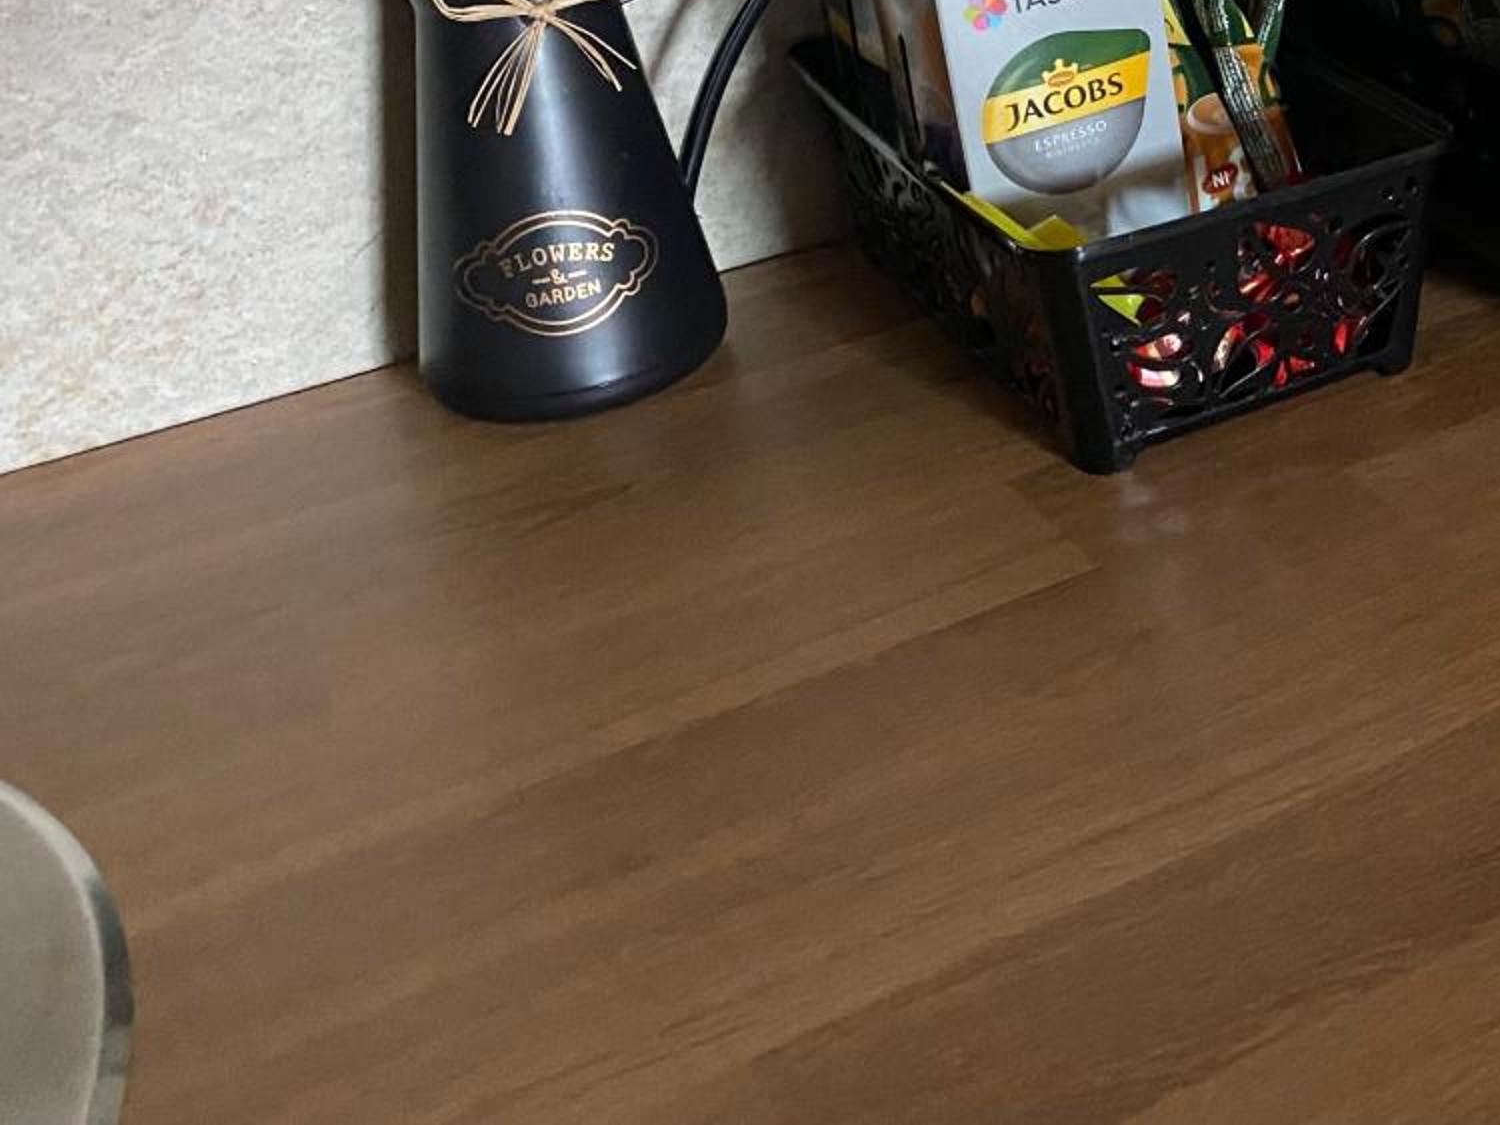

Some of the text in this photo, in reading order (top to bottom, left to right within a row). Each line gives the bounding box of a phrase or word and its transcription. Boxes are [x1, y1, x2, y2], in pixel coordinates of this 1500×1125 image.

[1005, 71, 1124, 132] JACOBS
[1033, 119, 1108, 153] ESPRESSO
[498, 242, 616, 280] FLOWERS
[550, 268, 567, 285] &
[524, 279, 602, 310] GARDEN
